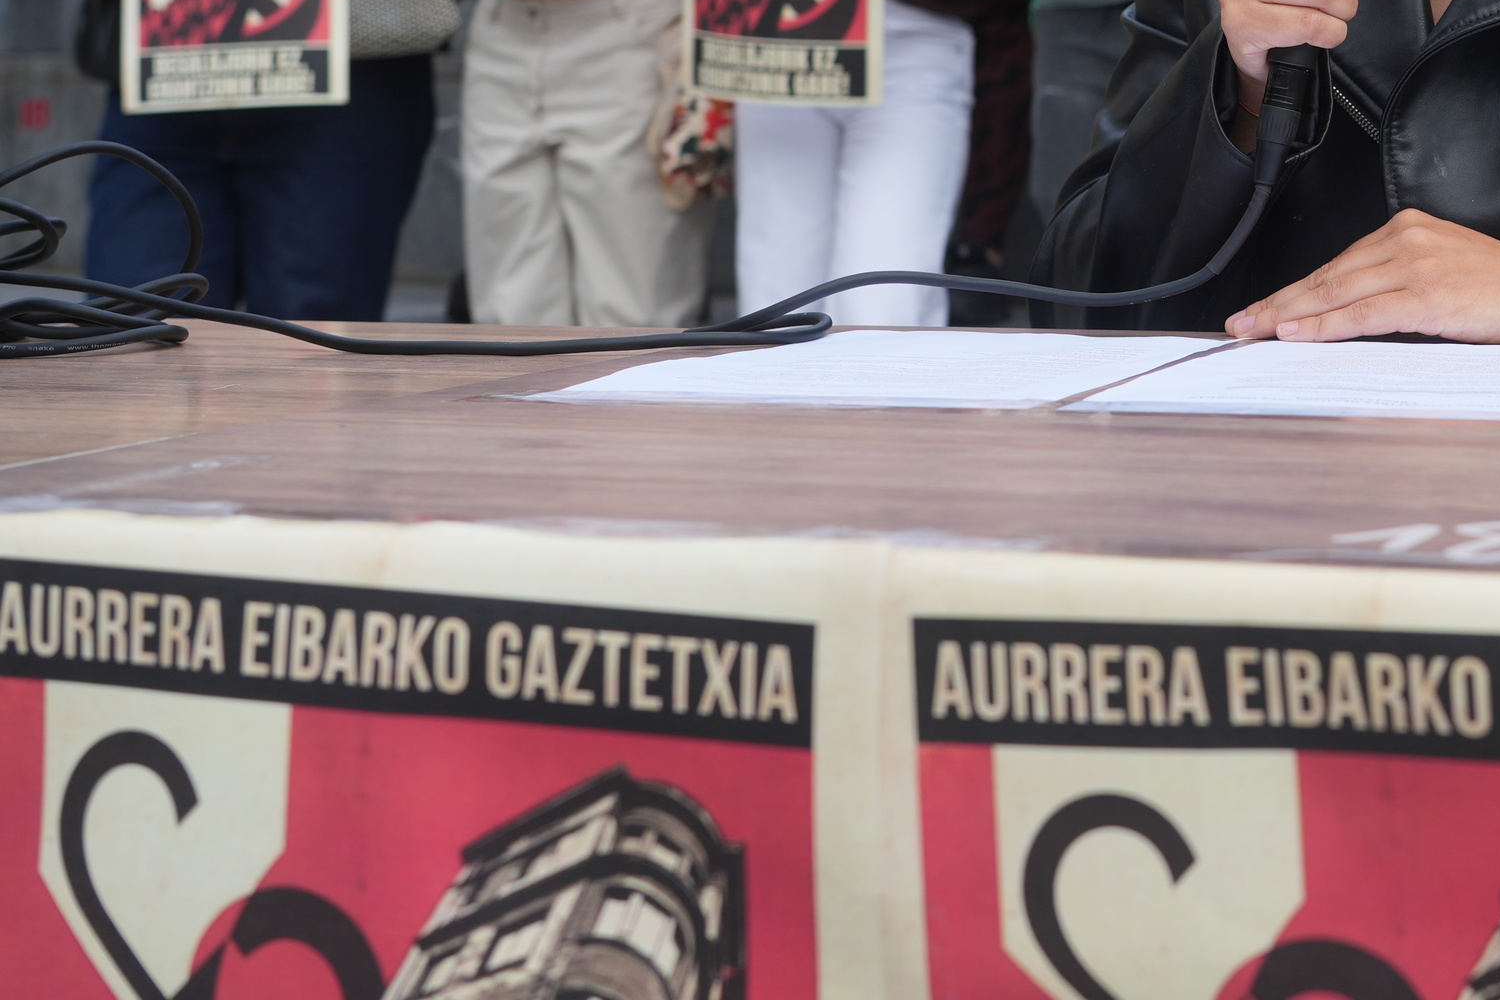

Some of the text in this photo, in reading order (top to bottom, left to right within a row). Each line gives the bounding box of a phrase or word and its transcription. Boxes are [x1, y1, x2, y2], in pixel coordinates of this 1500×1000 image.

[0, 580, 800, 724] AURRERA EIBARKO GAZTETXIA
[931, 639, 1212, 728] AURRERA
[1224, 645, 1494, 740] EIBARKO
